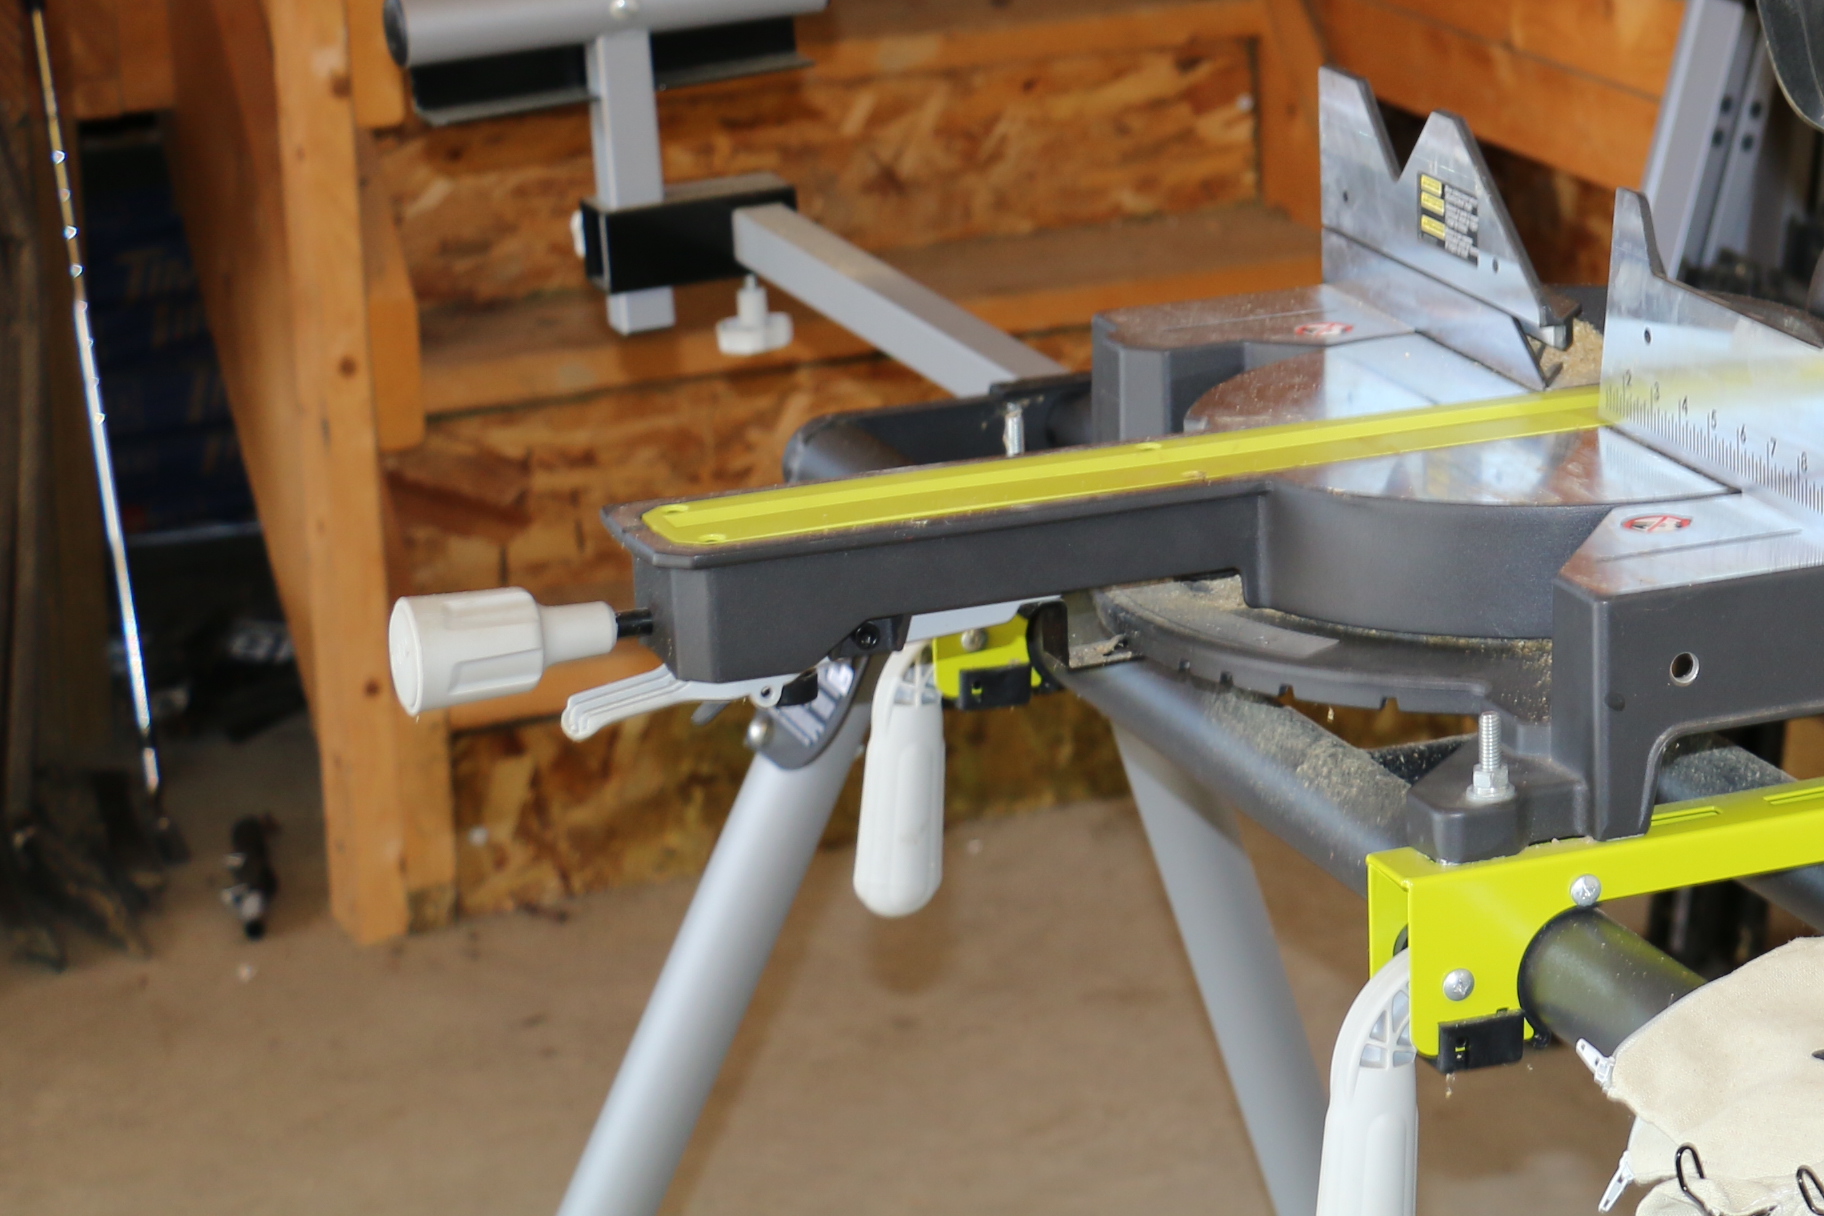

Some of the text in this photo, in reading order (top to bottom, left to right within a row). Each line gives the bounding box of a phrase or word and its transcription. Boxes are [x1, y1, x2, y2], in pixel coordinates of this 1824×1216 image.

[1625, 369, 1632, 386] 2
[1654, 381, 1660, 400] 3
[1682, 396, 1688, 413] 4
[1711, 410, 1717, 429] 5
[1740, 425, 1746, 443] 6
[1770, 438, 1777, 456] 7
[1801, 452, 1808, 472] 8
